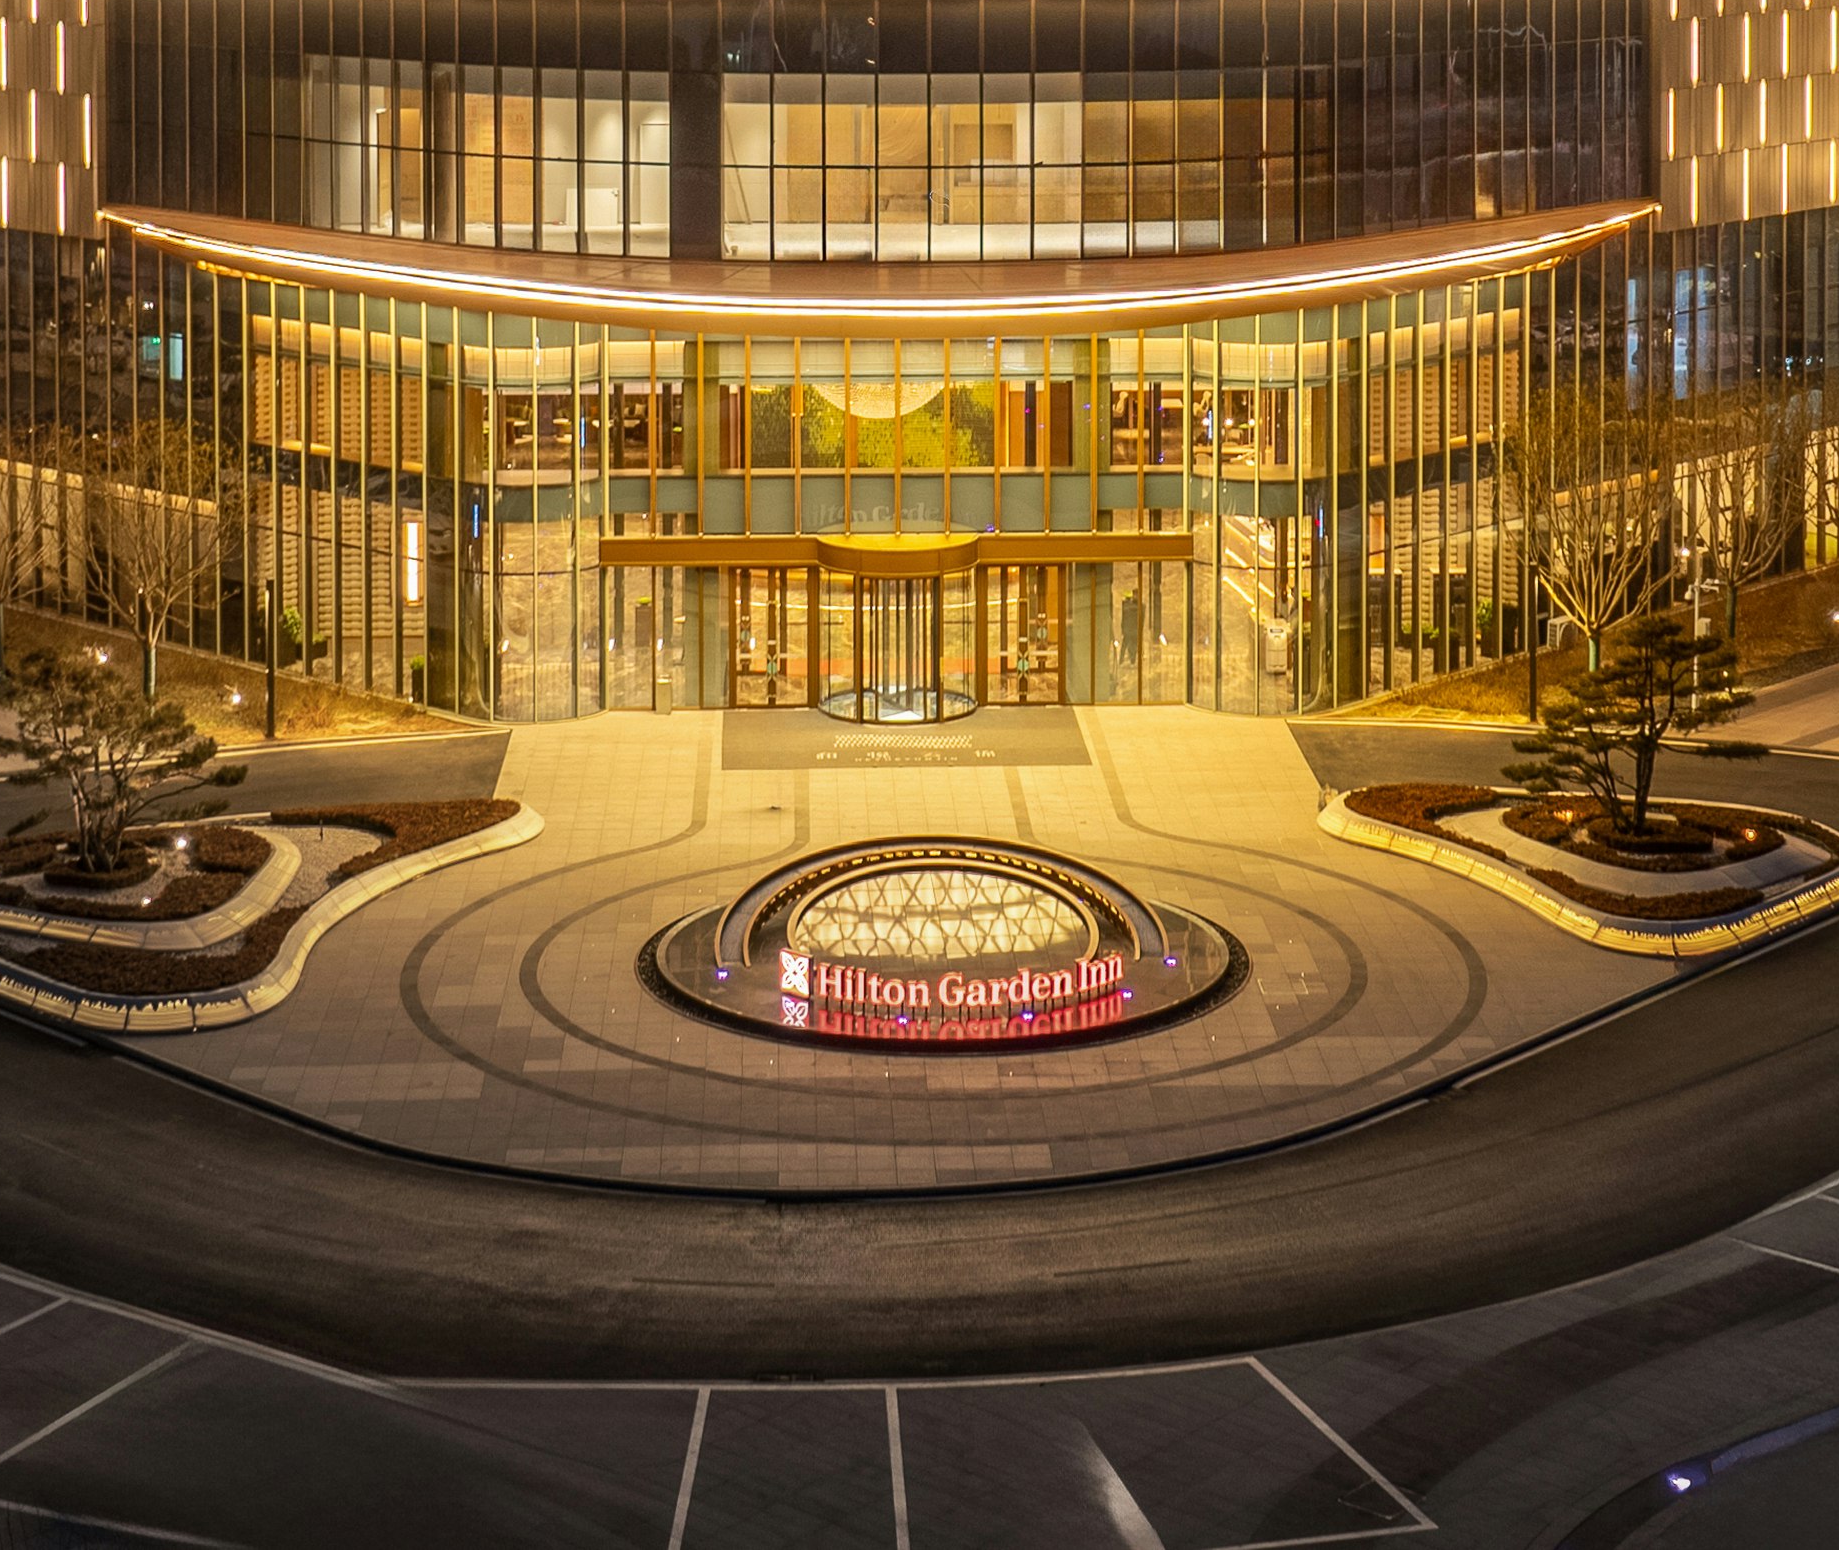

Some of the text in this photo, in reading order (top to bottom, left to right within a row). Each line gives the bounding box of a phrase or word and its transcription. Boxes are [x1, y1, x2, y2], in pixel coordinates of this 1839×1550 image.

[816, 953, 1124, 1007] Hilton Garden Inn
